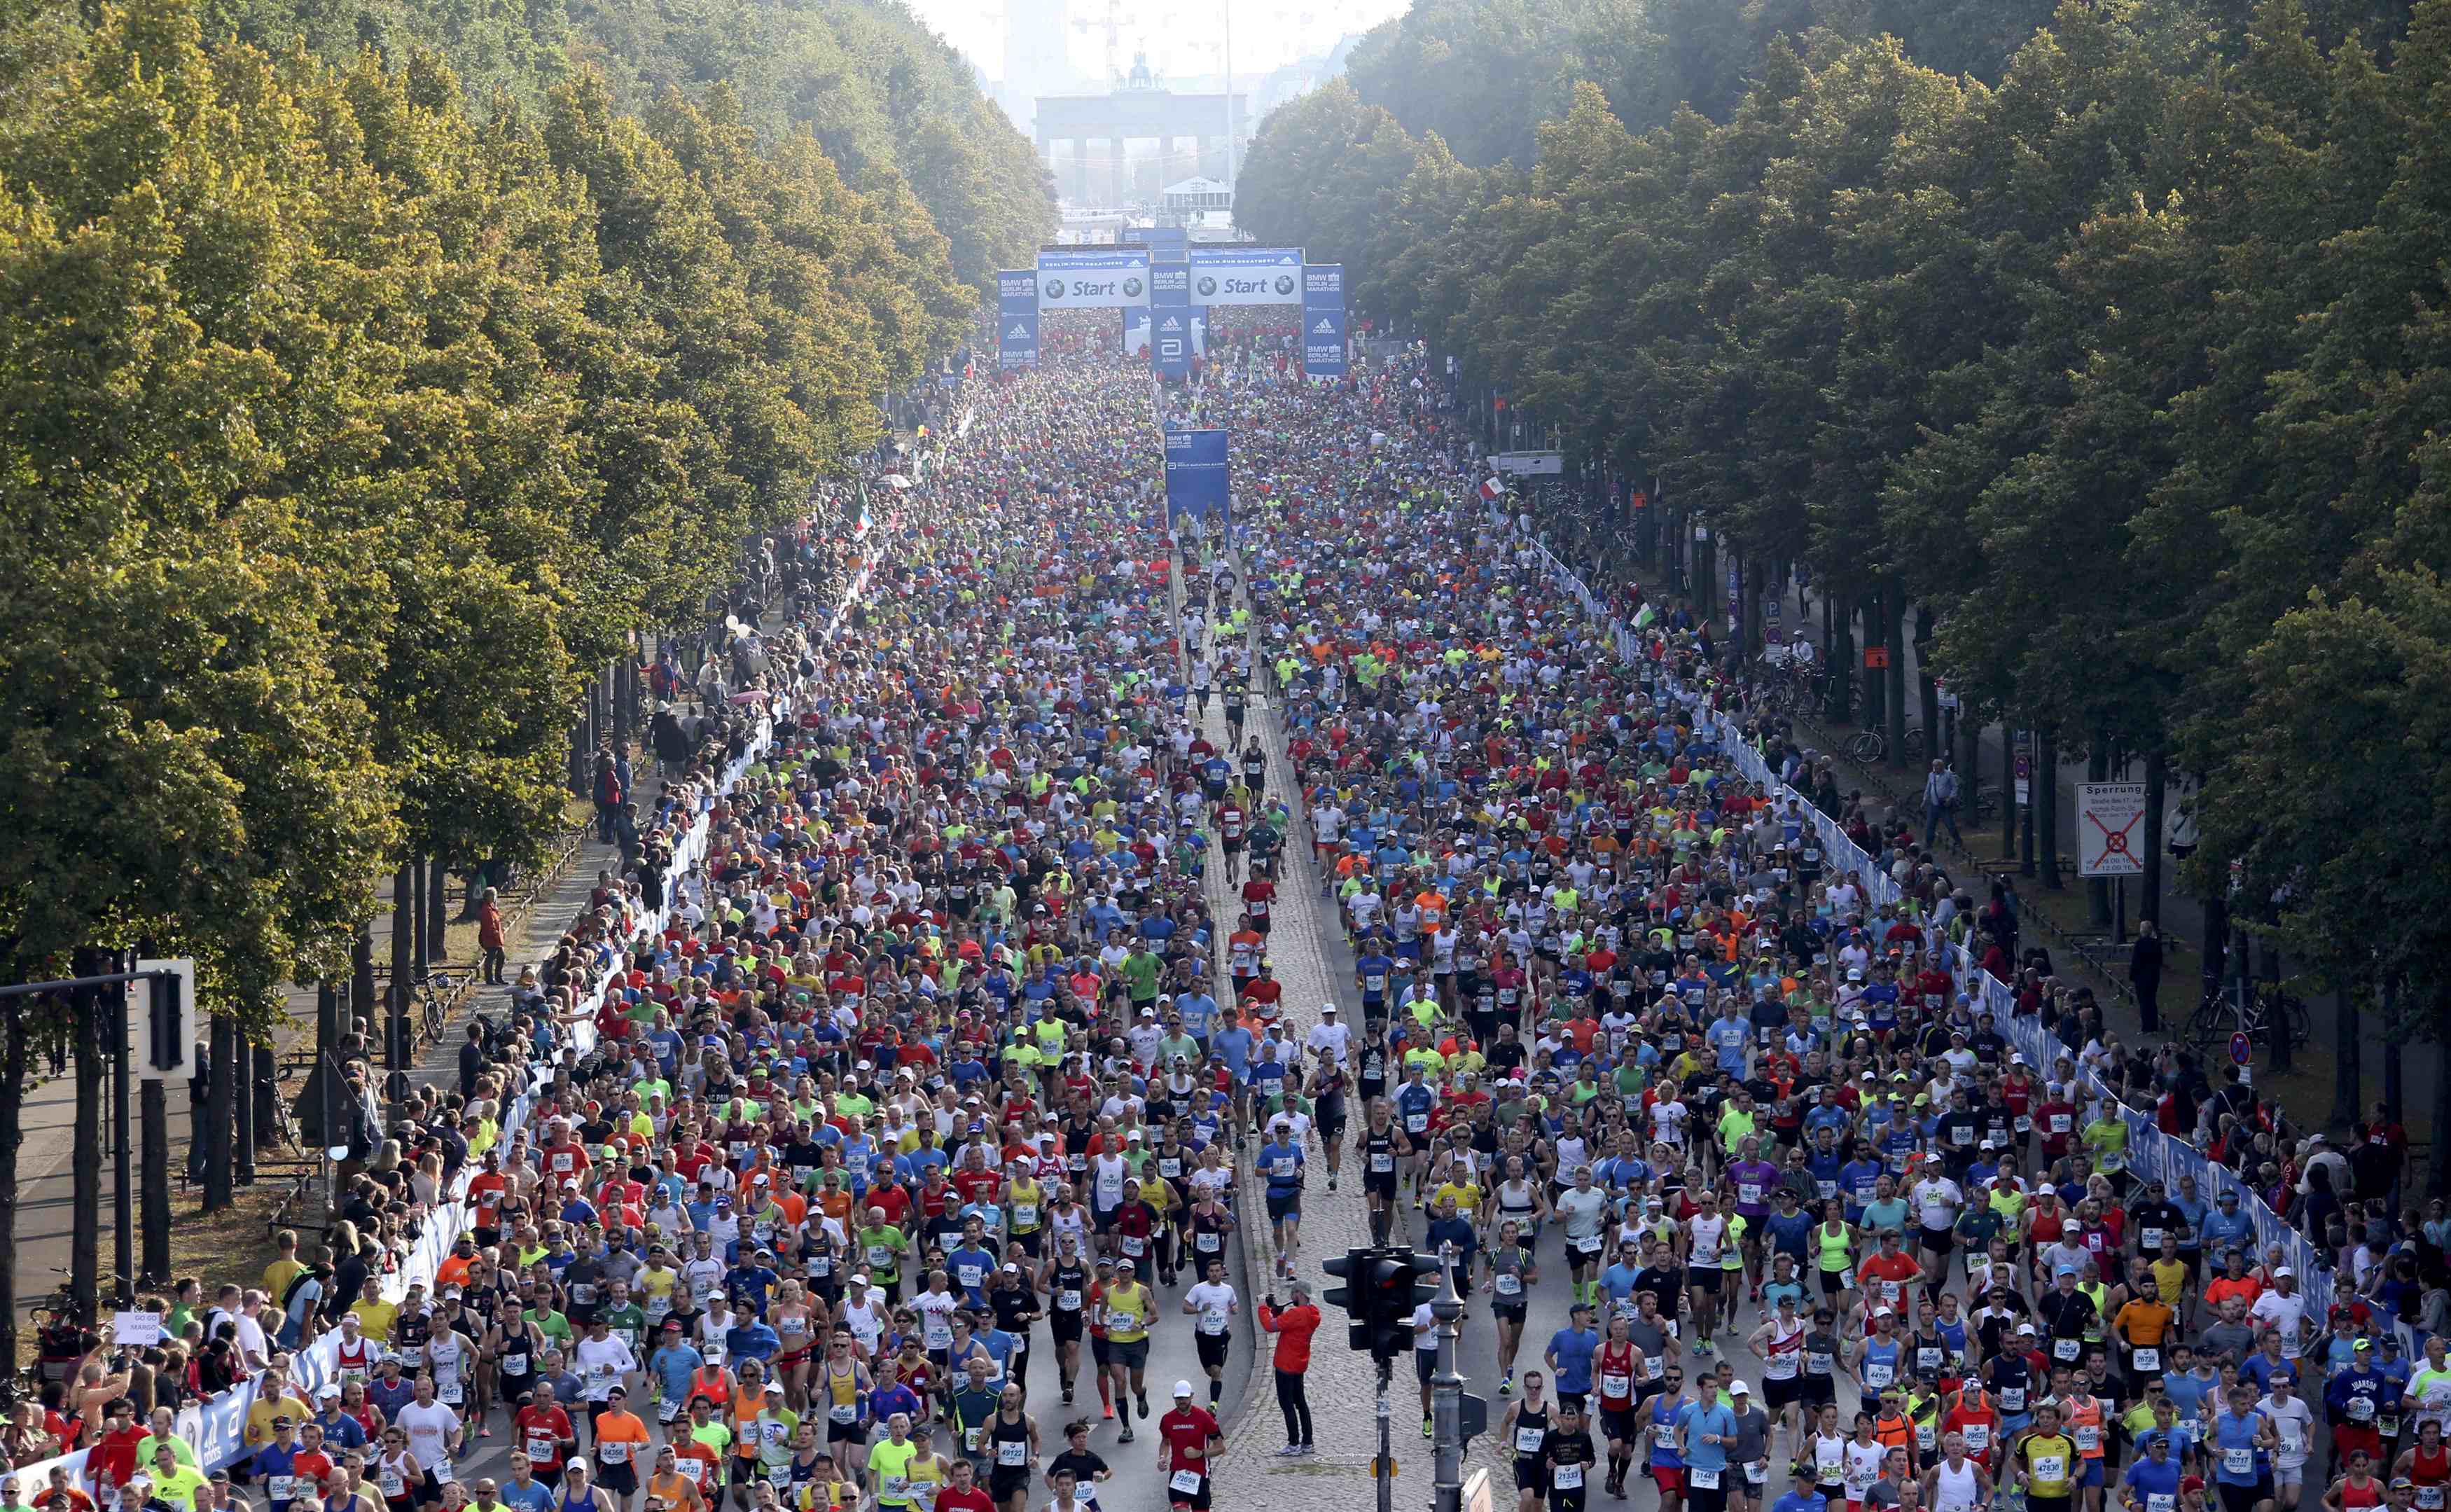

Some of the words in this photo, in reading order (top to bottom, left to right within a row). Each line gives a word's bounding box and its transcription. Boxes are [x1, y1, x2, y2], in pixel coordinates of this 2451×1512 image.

[1072, 281, 1116, 296] Start
[1224, 279, 1268, 293] Start
[1768, 602, 1777, 616] P
[2086, 786, 2141, 796] Sperrung
[2351, 1381, 2377, 1392] JUANSON
[1001, 1448, 1022, 1457] 49122
